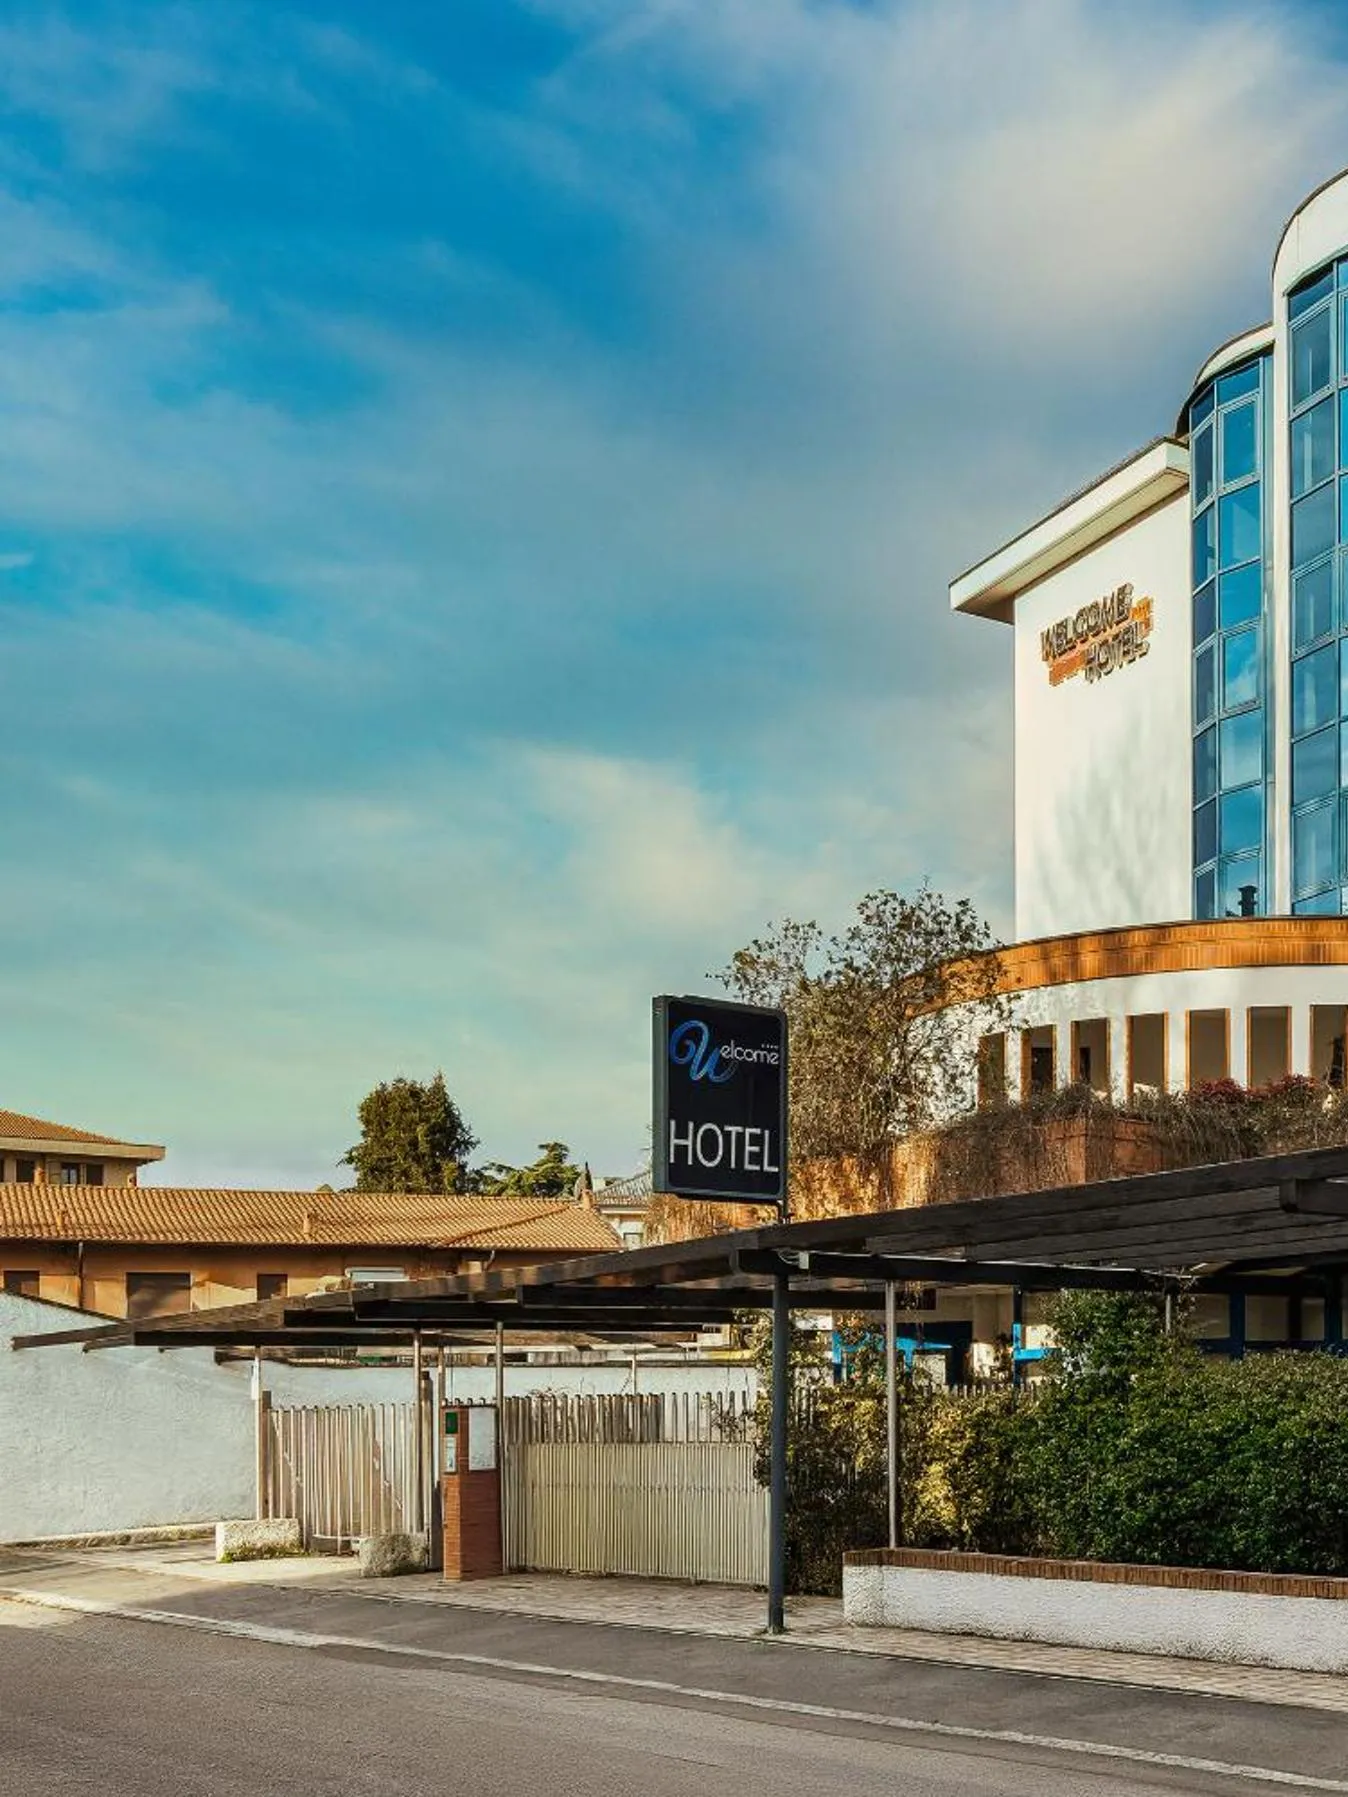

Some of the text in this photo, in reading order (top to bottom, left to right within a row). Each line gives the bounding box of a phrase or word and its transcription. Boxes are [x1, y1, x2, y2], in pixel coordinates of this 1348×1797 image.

[1040, 582, 1134, 662] WELCOME
[1085, 620, 1150, 683] HOTEL
[670, 1020, 779, 1082] Welcome
[669, 1119, 779, 1173] HOTEL
